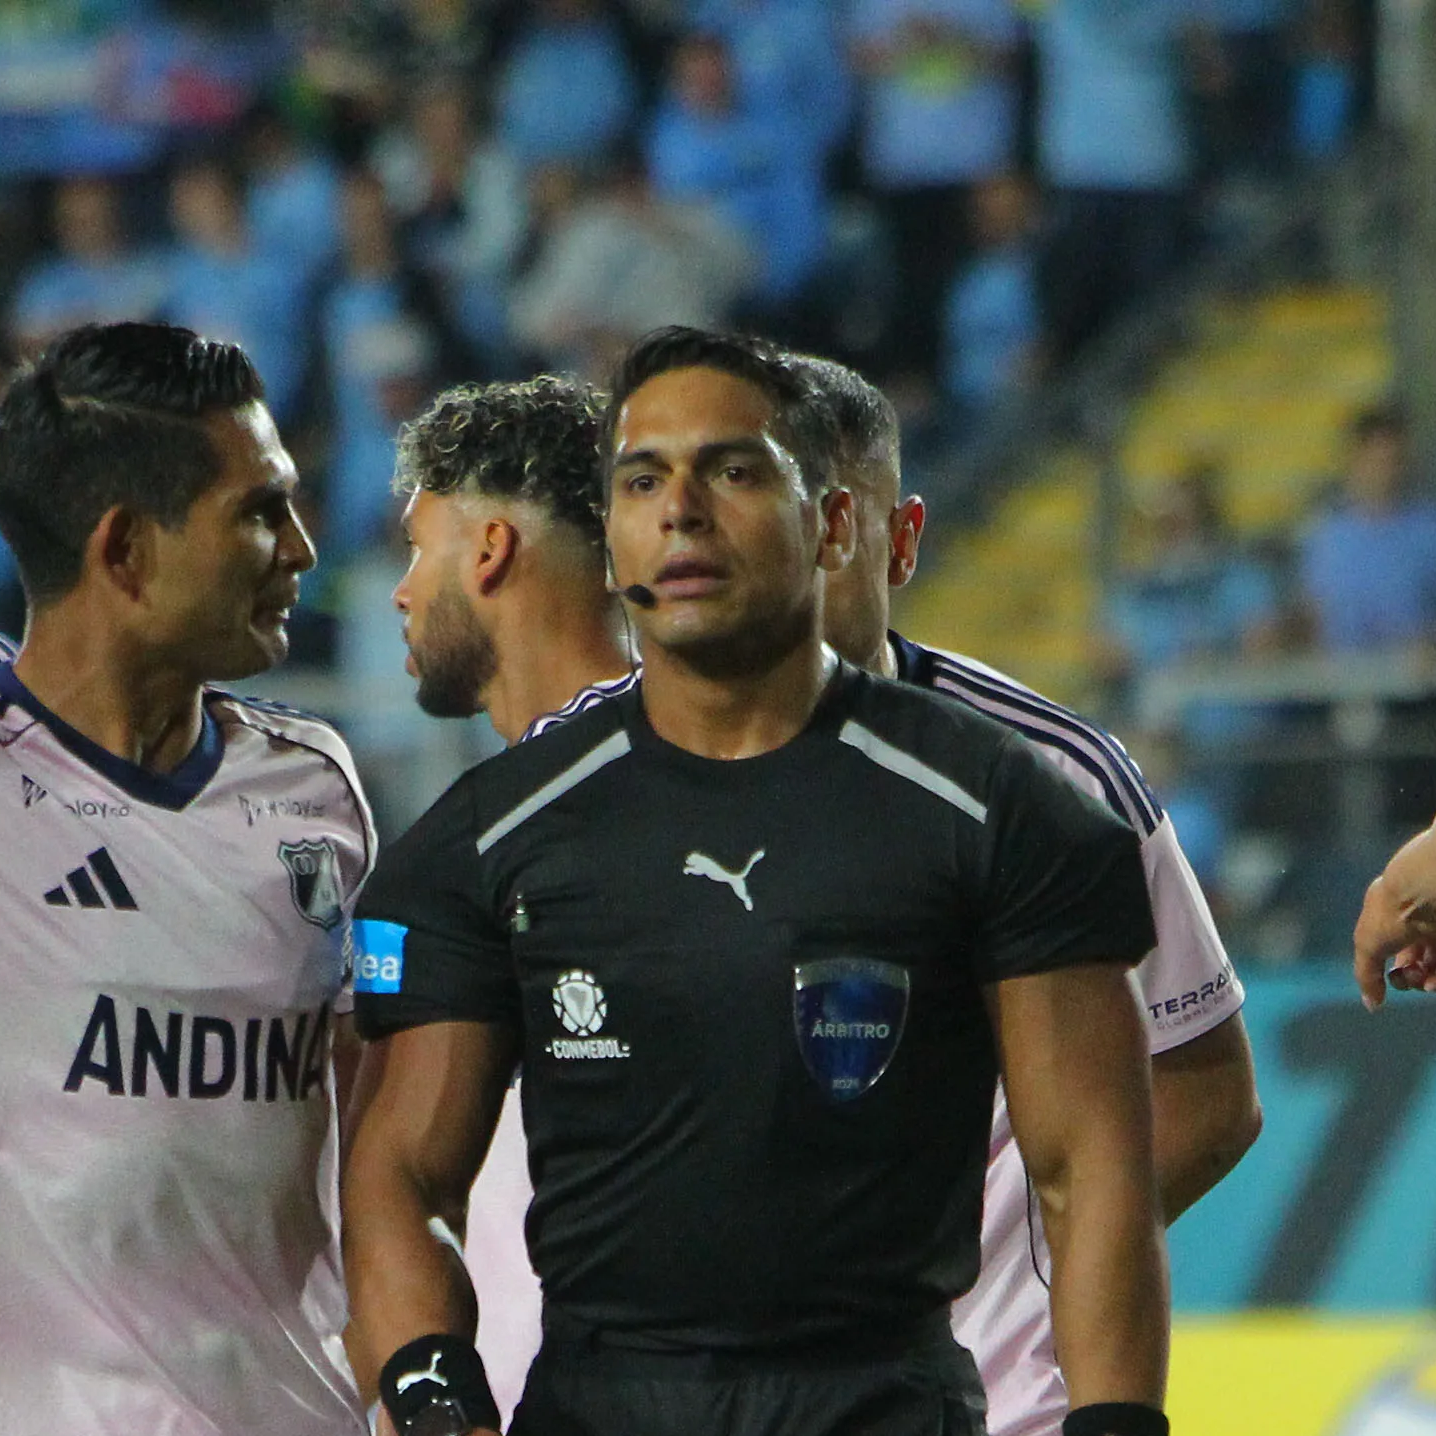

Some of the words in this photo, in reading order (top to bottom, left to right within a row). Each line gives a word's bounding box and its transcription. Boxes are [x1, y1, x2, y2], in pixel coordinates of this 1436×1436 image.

[1148, 971, 1232, 1020] TERRA
[811, 1019, 891, 1039] ÁRBITRO
[551, 1038, 625, 1060] CONMEBOL
